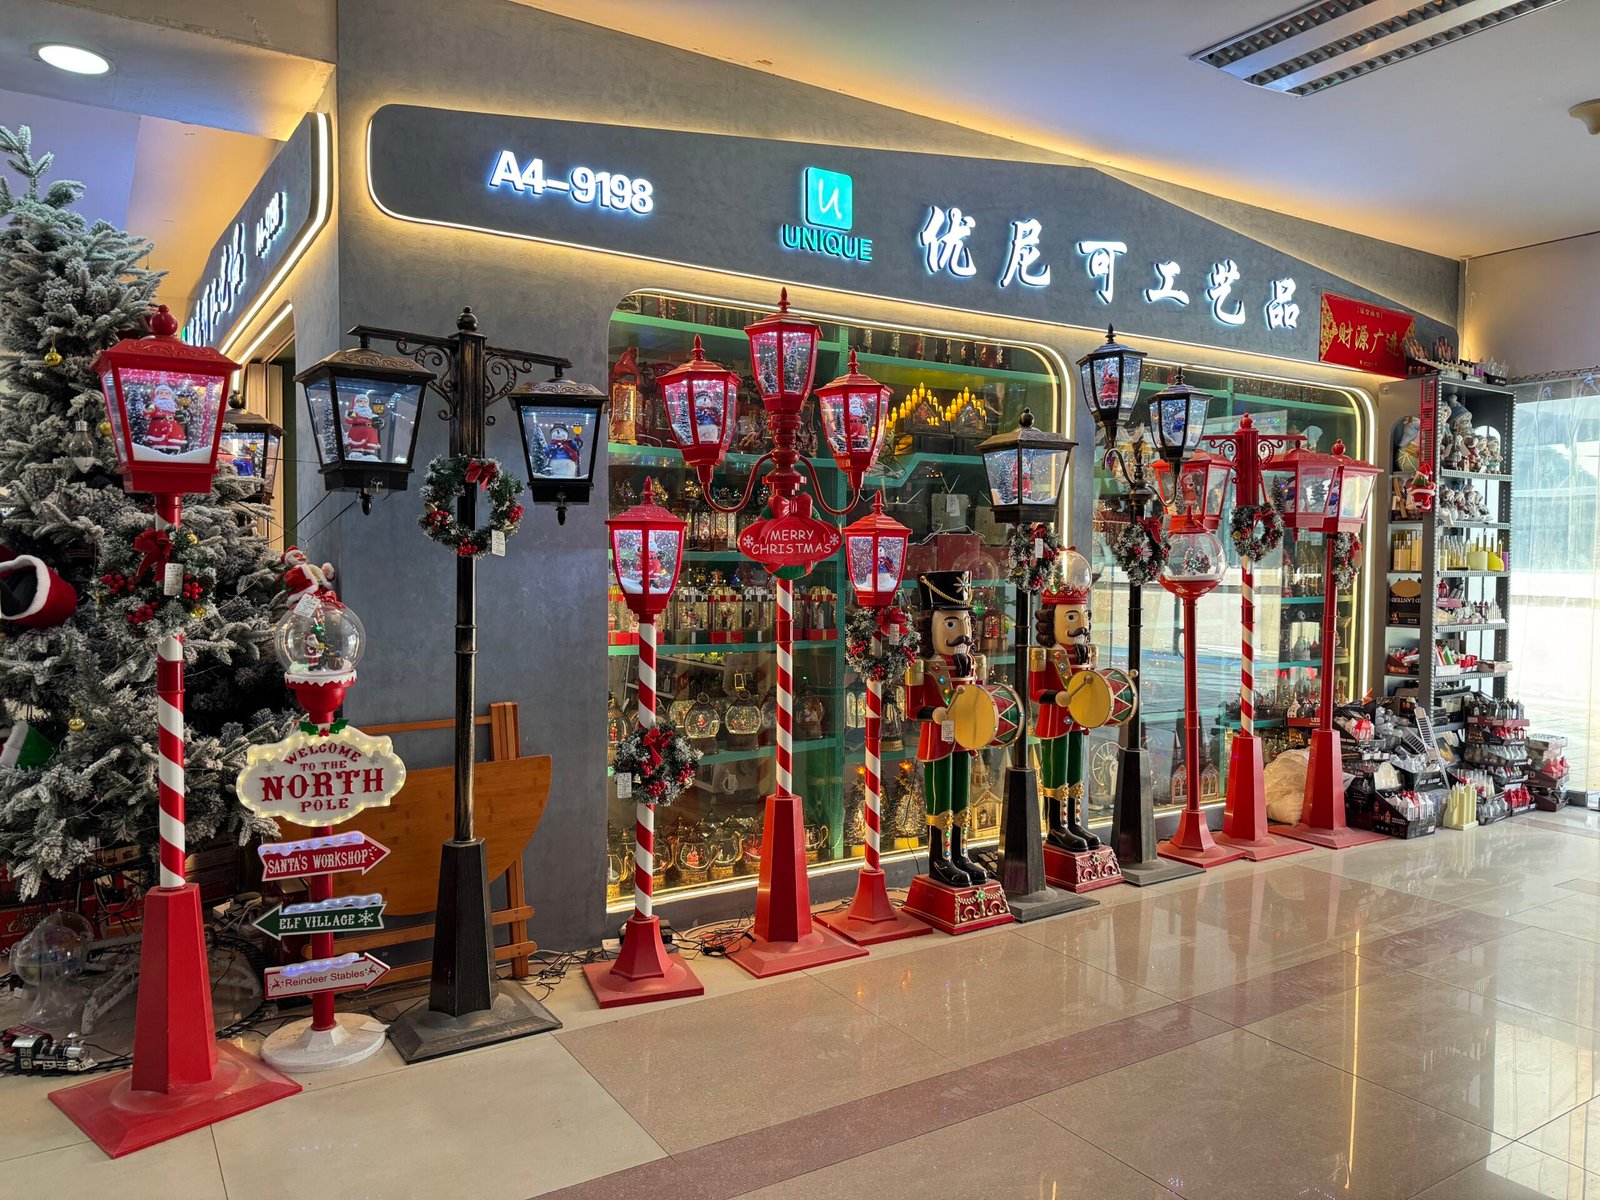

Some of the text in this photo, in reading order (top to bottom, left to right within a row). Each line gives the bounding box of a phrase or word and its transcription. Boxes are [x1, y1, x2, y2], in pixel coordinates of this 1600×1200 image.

[488, 150, 655, 214] A4-9198
[781, 224, 873, 262] UNIQUE
[919, 206, 1300, 331] 优尼可工艺品
[1337, 320, 1400, 357] 财源广进
[770, 529, 814, 541] MERRY
[751, 543, 832, 555] CHRISTMAS
[283, 742, 362, 767] WELCOME
[300, 760, 347, 772] TO THE
[259, 767, 385, 803] NORTH
[300, 797, 350, 813] POLE
[267, 848, 369, 876] SANTA'S WORKSHOP
[278, 912, 356, 930] ELF VILLAGE
[284, 968, 365, 988] Reindeer Stables
